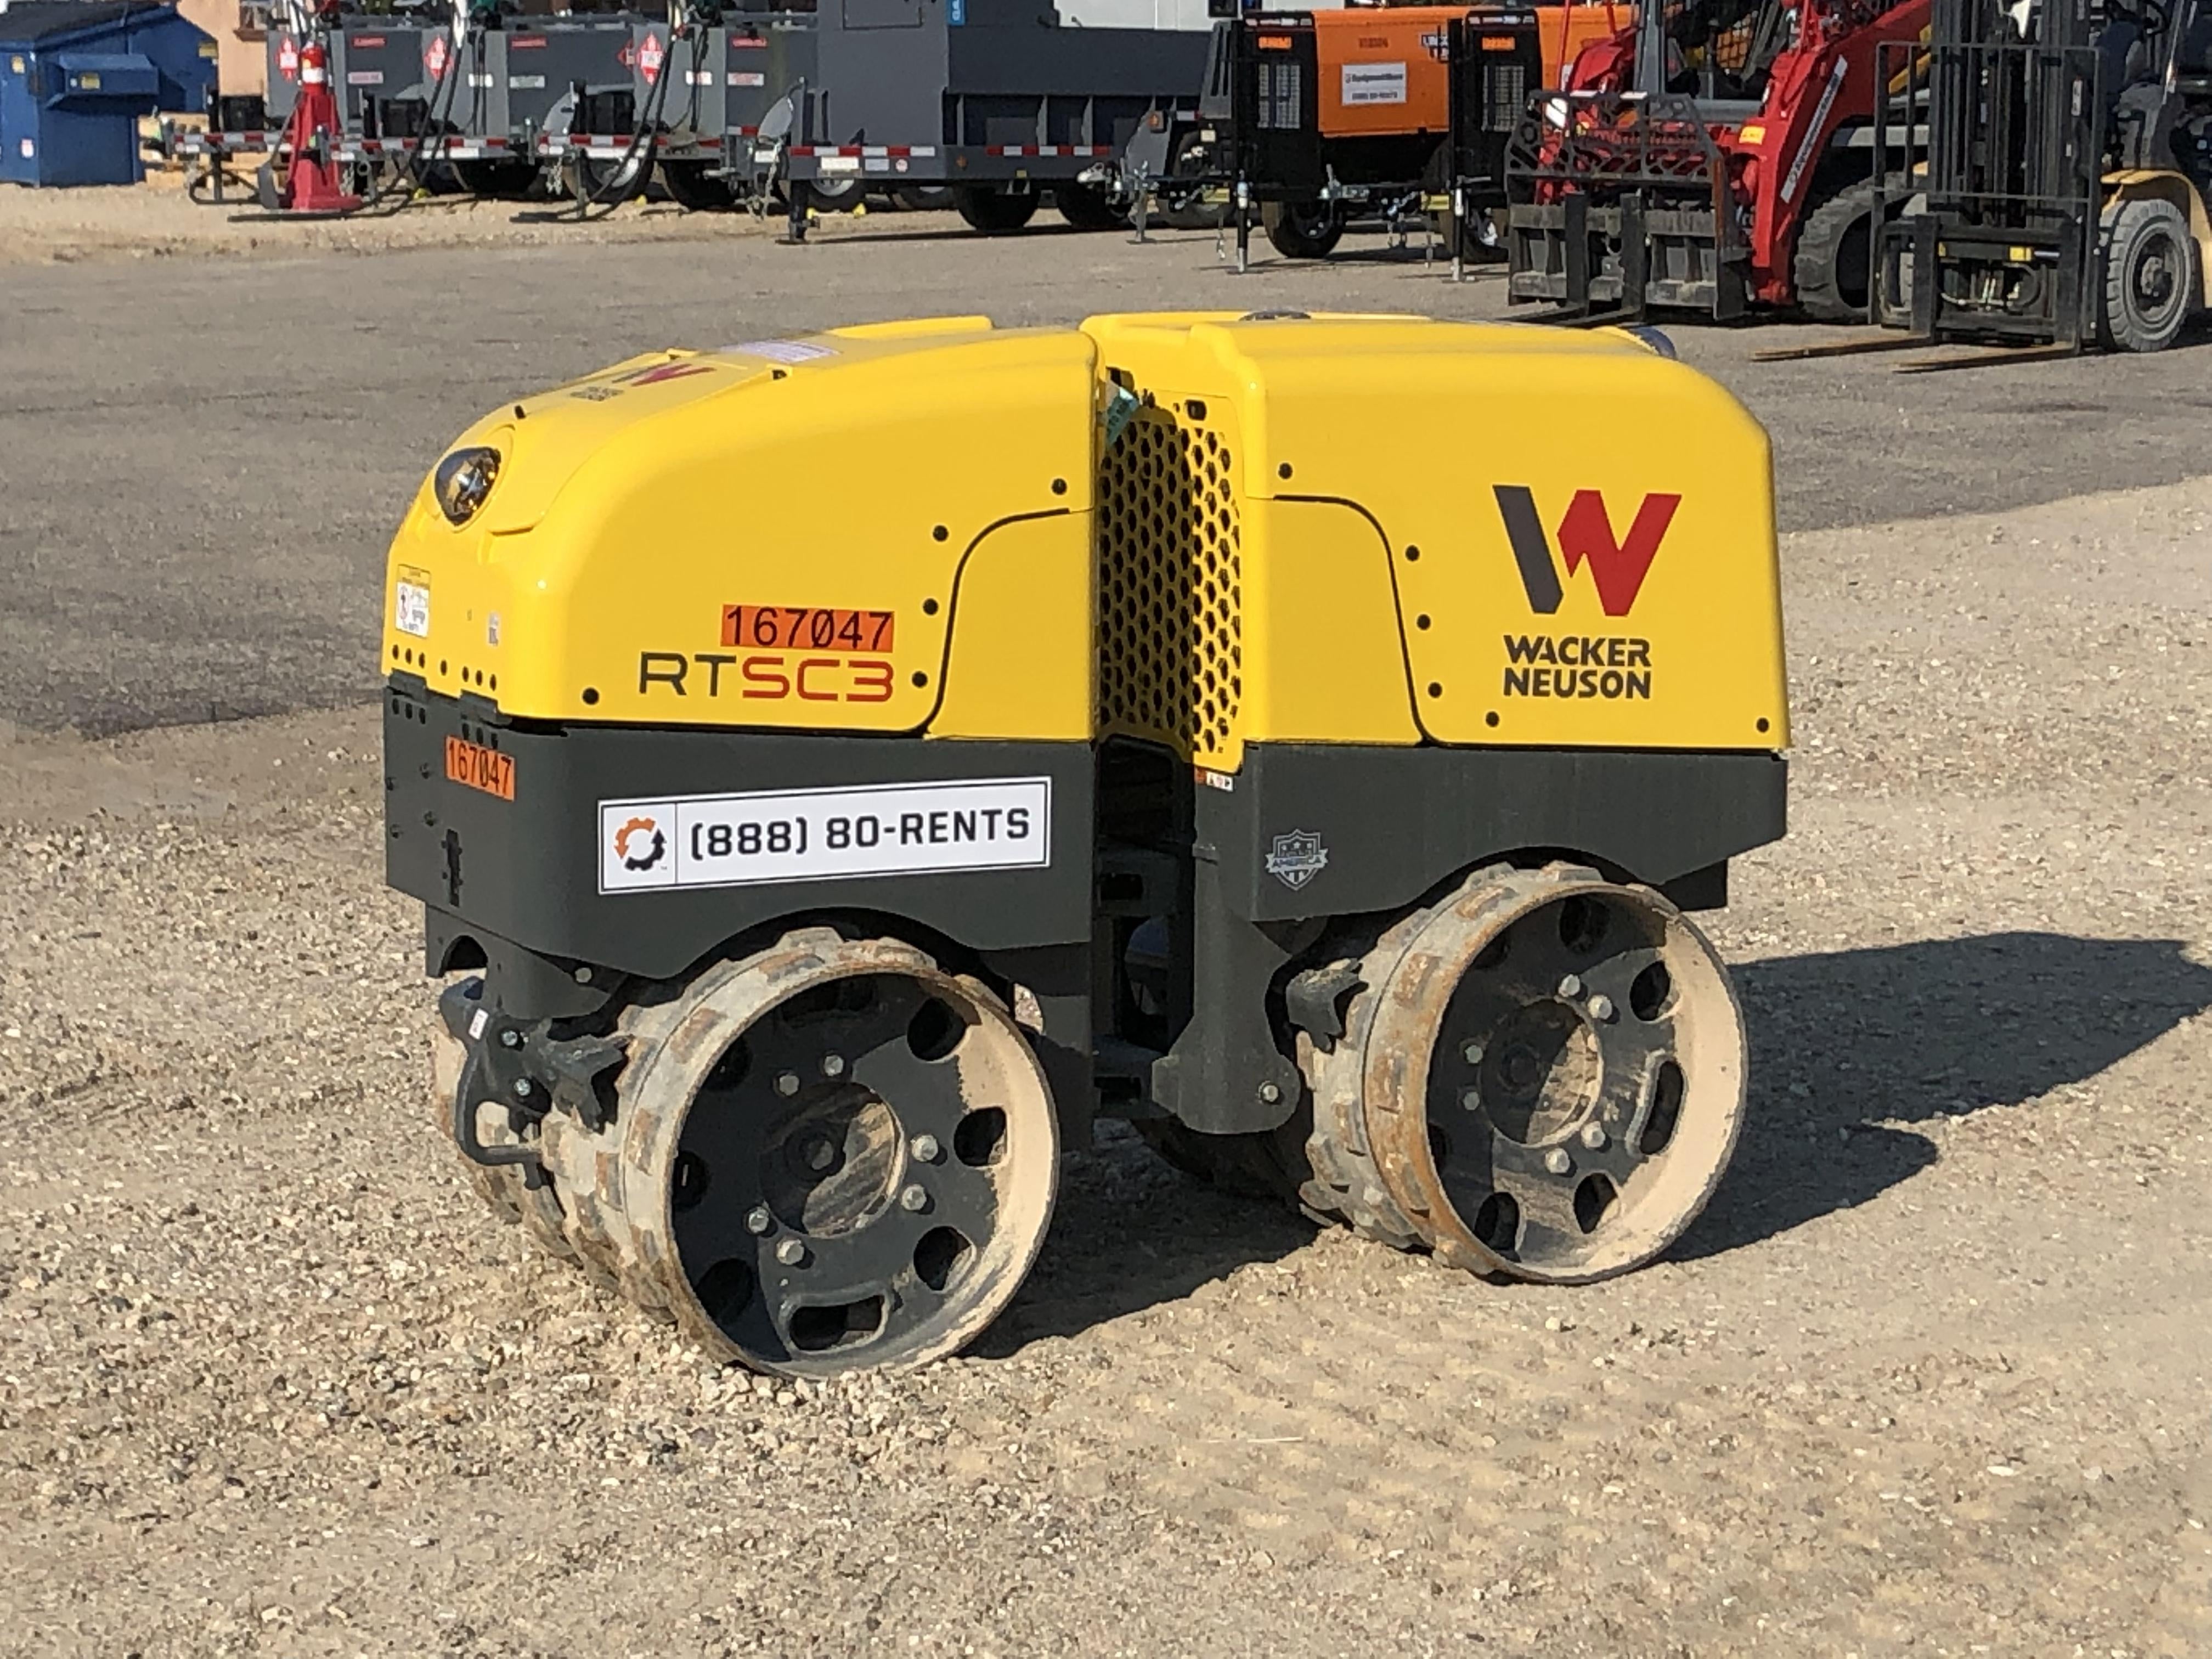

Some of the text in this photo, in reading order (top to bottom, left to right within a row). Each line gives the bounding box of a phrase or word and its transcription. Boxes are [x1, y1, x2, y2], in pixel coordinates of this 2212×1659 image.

[727, 605, 893, 651] 167047
[1503, 635, 1651, 667] WACKER
[639, 651, 894, 702] RTSC3
[1503, 668, 1651, 699] NEUSON
[449, 740, 511, 796] 167047
[691, 808, 1030, 860] (888) 80-RENTS
